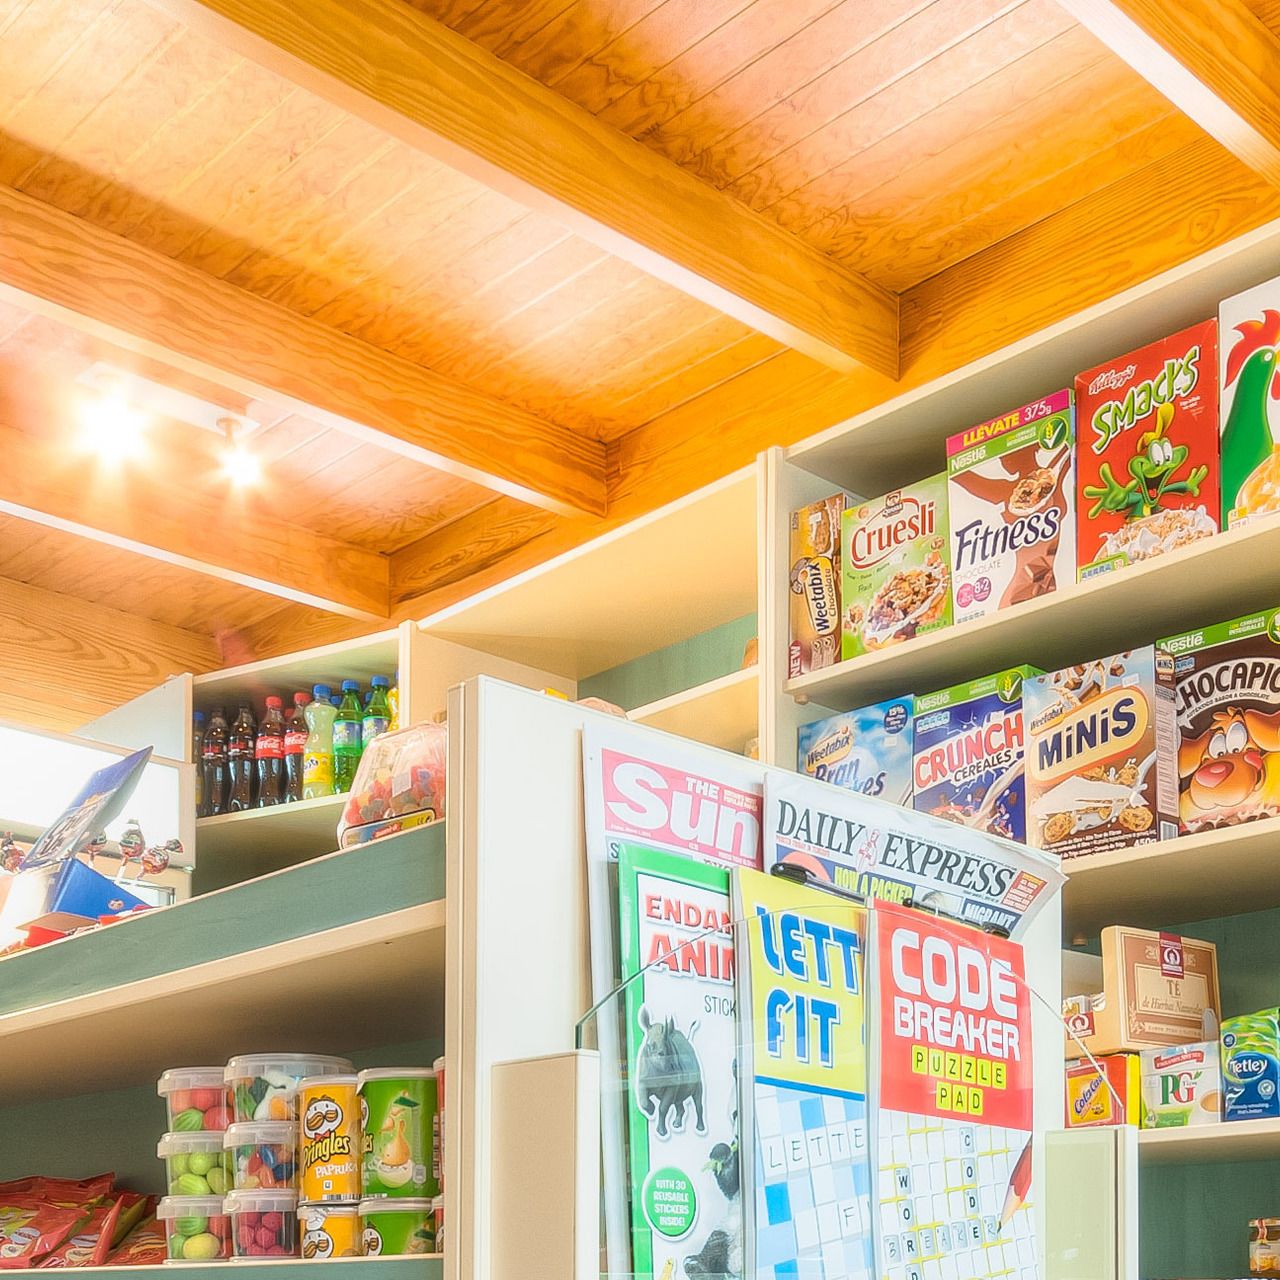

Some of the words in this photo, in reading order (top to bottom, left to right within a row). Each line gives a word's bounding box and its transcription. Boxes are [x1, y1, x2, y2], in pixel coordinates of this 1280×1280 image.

[1089, 363, 1138, 395] Kellogg's
[951, 446, 986, 471] Nestlé
[851, 501, 935, 563] Cruesli
[954, 508, 1059, 571] Fitness
[954, 559, 1001, 584] CHOCOLATE
[807, 562, 830, 632] Weetabix
[823, 567, 837, 617] Chocolate
[790, 644, 802, 679] NEW
[806, 733, 852, 768] Weetabix
[915, 712, 1023, 789] CRUNCH
[954, 750, 1013, 783] CEREALES
[686, 777, 719, 800] THE
[607, 762, 759, 859] Sun
[776, 800, 865, 856] DAILY
[880, 833, 1016, 897] EXPRESS
[891, 928, 1017, 1019] CODE
[767, 988, 840, 1068] FIT
[895, 996, 1020, 1061] BREAKER
[916, 1052, 1002, 1084] PUZZLE
[1229, 1058, 1268, 1079] Tetley
[940, 1088, 980, 1109] PAD
[1160, 1073, 1195, 1106] PG
[304, 1131, 350, 1168] Pringles
[654, 1191, 689, 1203] REUSABLE
[656, 1179, 674, 1190] WITH
[676, 1180, 686, 1190] 30
[655, 1204, 689, 1215] STICKERS
